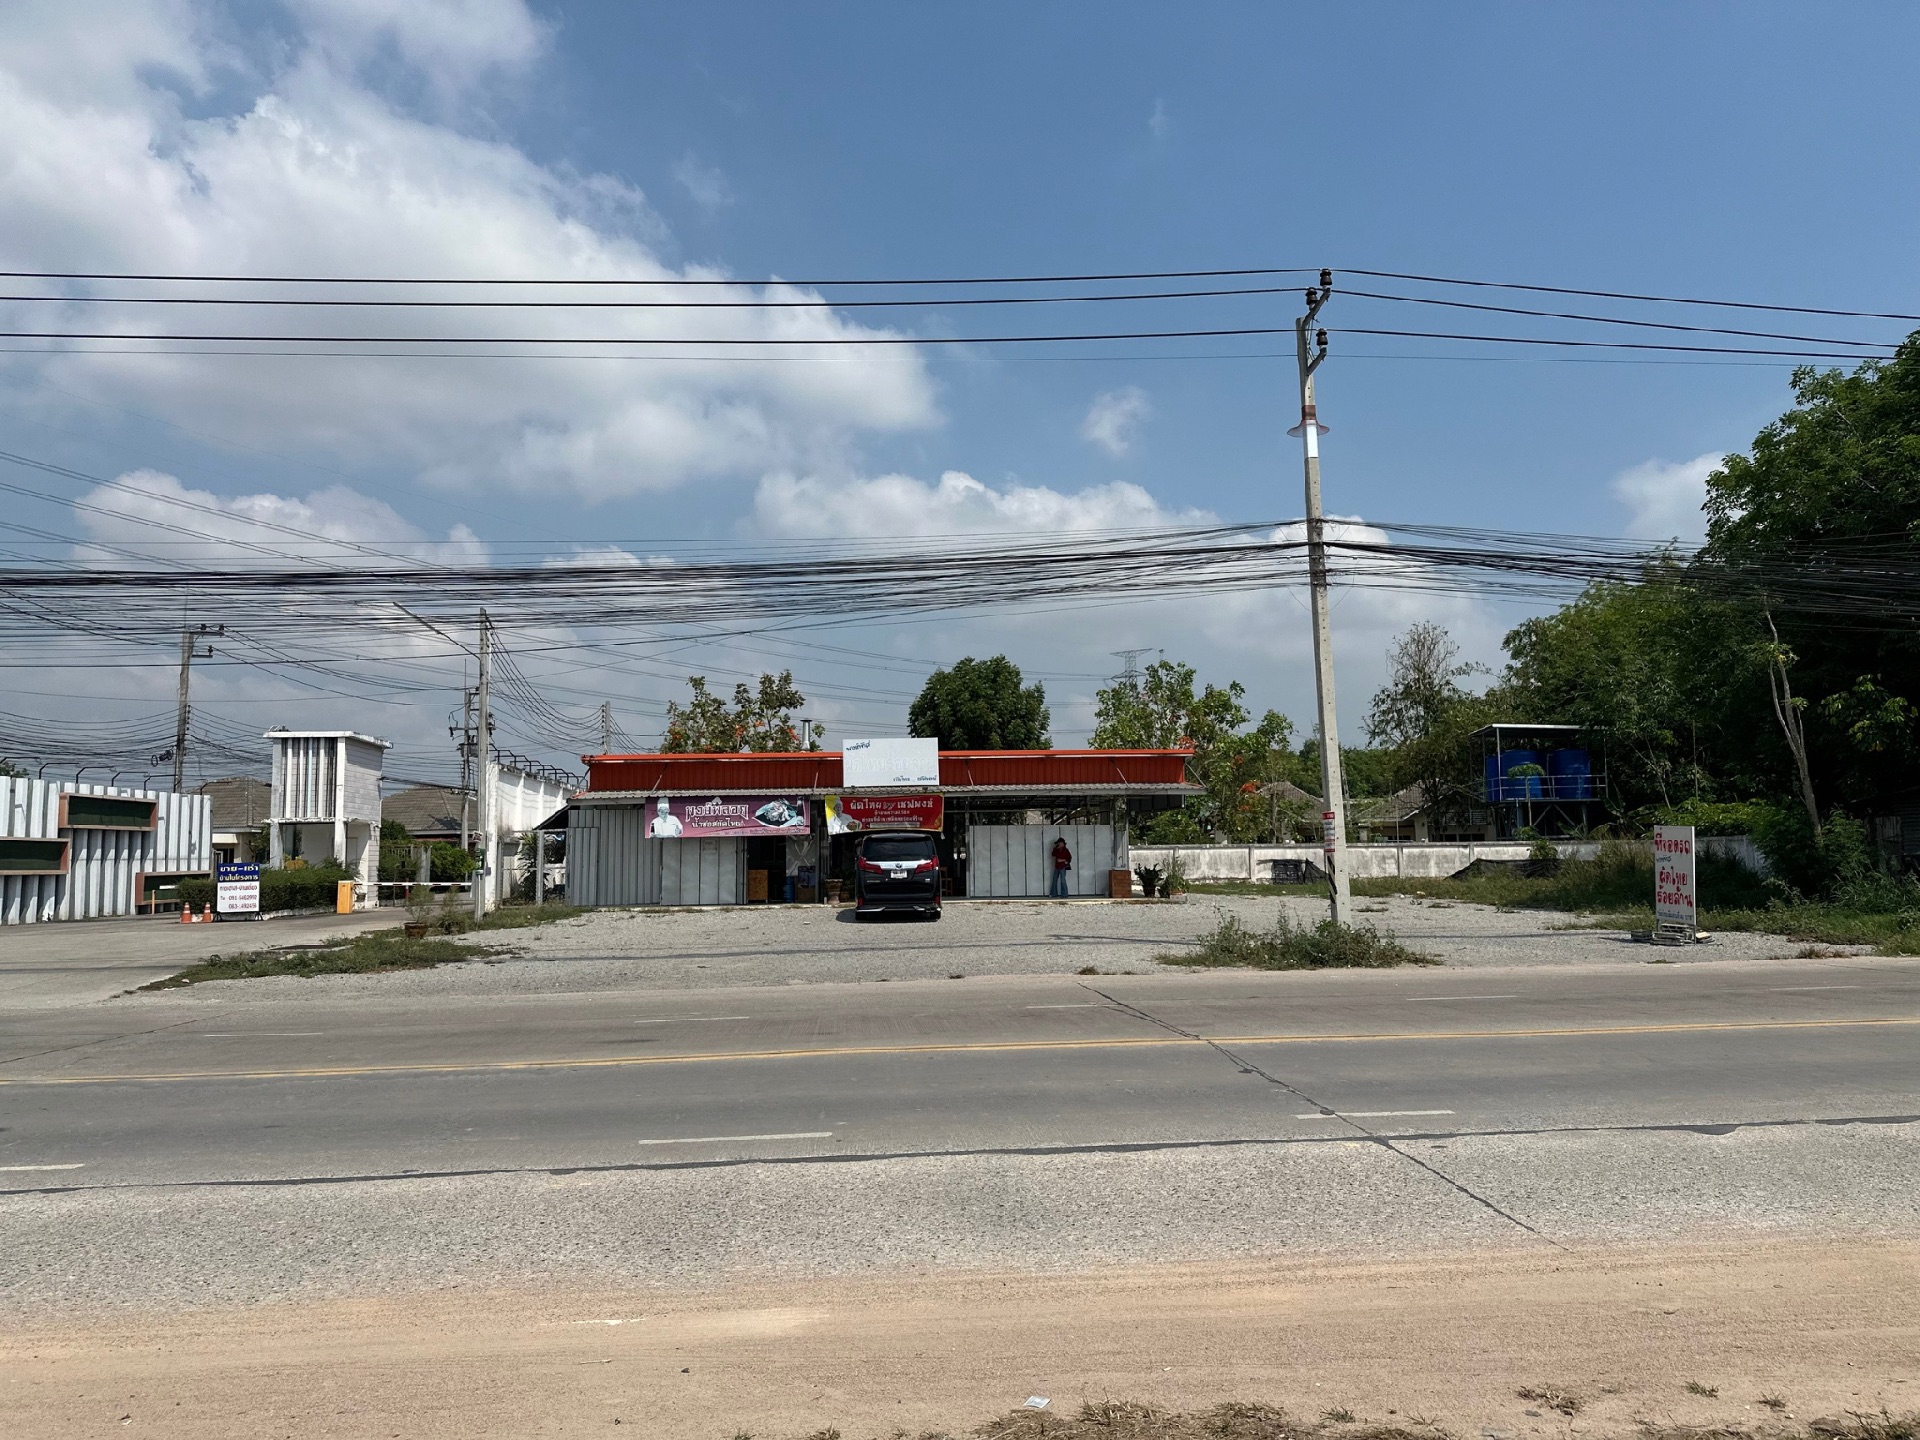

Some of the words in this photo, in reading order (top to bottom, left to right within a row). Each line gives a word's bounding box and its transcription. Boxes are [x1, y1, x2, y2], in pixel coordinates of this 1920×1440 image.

[1654, 827, 1690, 854] ที่จอดรถ
[1659, 866, 1687, 885] ผัดไทย
[1657, 885, 1693, 907] ร้อยล้าน
